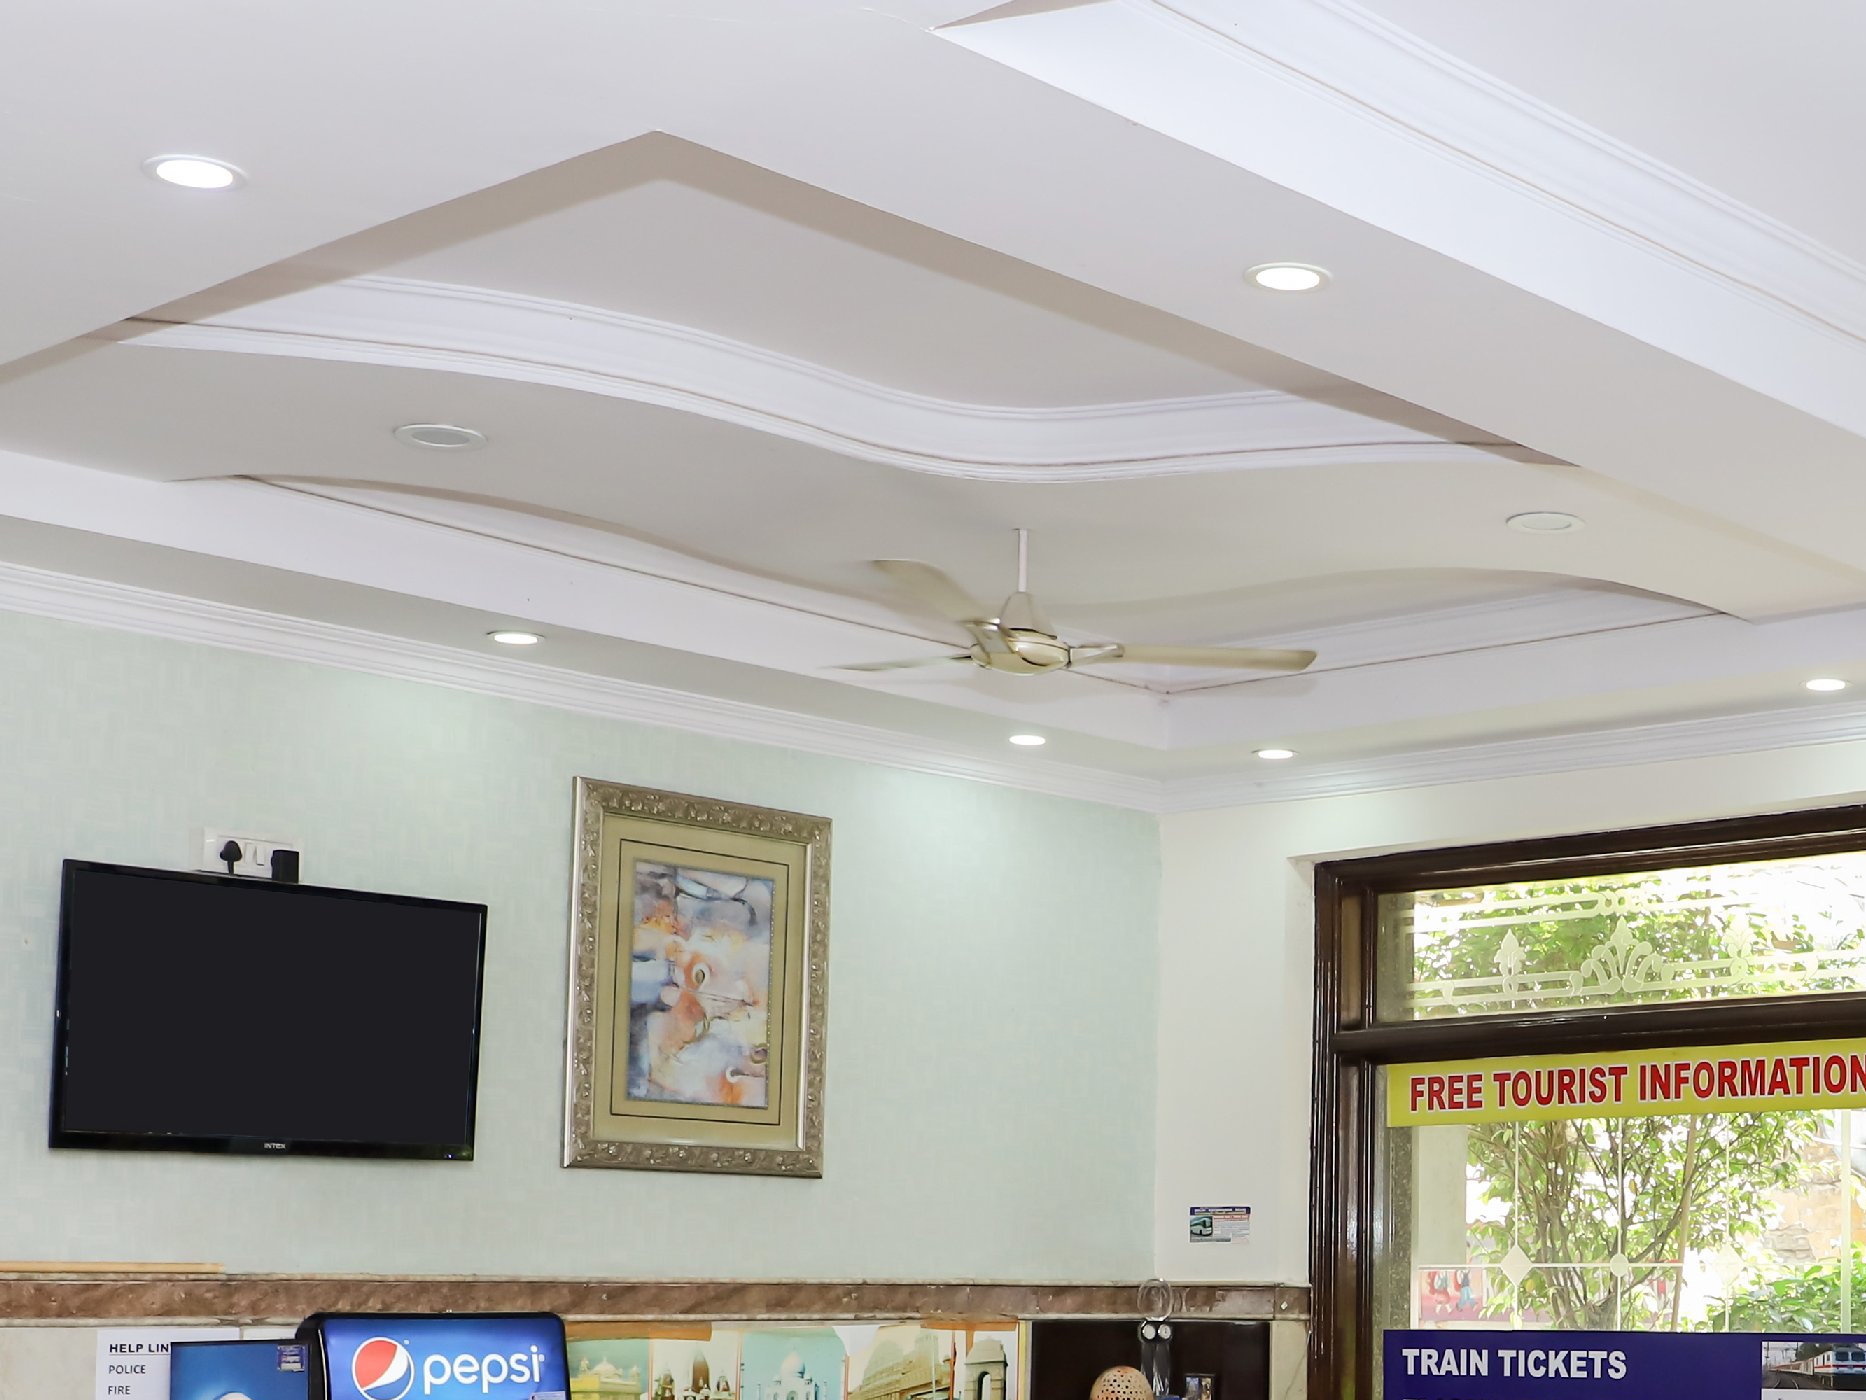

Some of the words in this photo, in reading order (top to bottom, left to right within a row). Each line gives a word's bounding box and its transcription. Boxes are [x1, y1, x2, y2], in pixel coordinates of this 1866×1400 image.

[1410, 1073, 1484, 1113] FREE
[1493, 1066, 1629, 1107] TOURIST
[109, 1344, 143, 1353] HELP
[148, 1344, 169, 1353] LIN
[108, 1365, 146, 1375] POLICE
[423, 1345, 544, 1395] pepsi
[1402, 1349, 1488, 1376] TRAIN
[1498, 1350, 1627, 1379] TICKETS
[107, 1386, 131, 1395] FIRE
